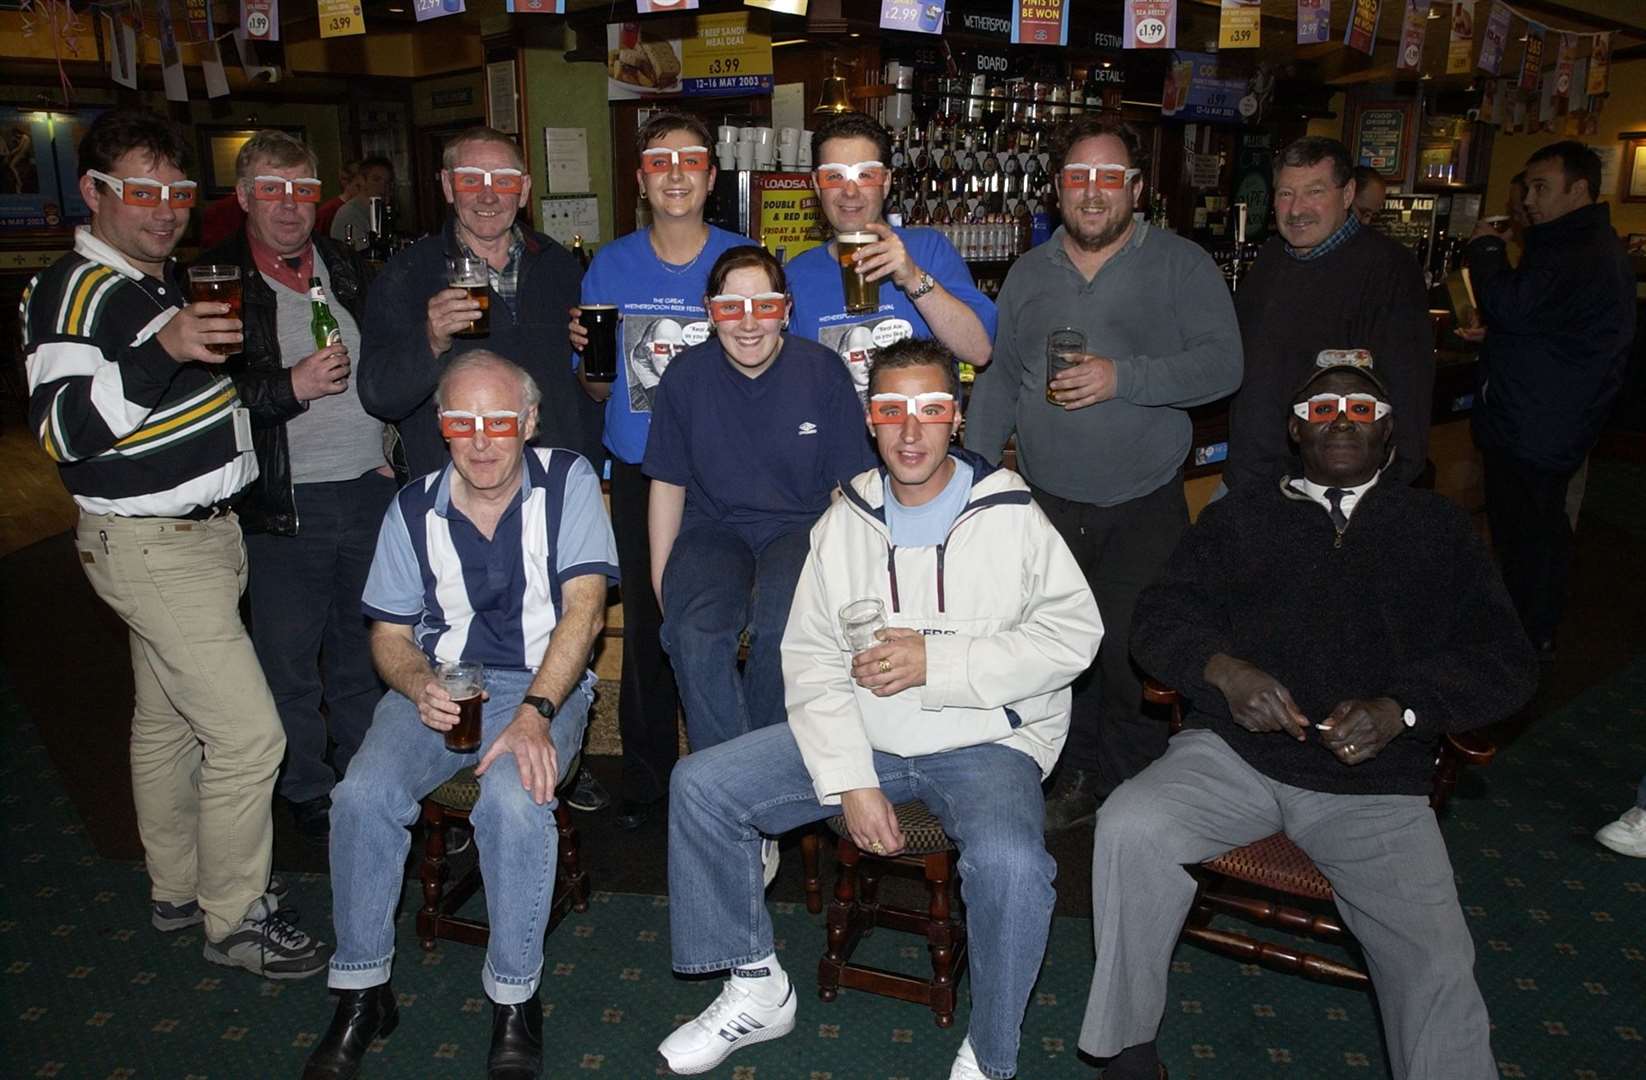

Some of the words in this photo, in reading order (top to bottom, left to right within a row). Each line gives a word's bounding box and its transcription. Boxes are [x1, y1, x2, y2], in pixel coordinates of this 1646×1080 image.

[885, 7, 918, 21] £2.99
[1022, 8, 1033, 18] BE
[1035, 8, 1060, 20] WON
[249, 17, 267, 29] £1.99
[330, 16, 351, 31] £3.99
[963, 14, 1011, 33] WETHERSPOO
[1139, 24, 1163, 37] £1.99
[1229, 30, 1252, 42] £3.99
[1095, 32, 1122, 48] FESTIV
[709, 58, 740, 74] £3.99
[977, 54, 1009, 72] BOARD
[695, 78, 717, 89] 12-16
[719, 77, 737, 88] MAY
[739, 76, 759, 86] 2003
[764, 179, 807, 189] LOADSA
[763, 200, 796, 209] DOUBLE
[1385, 199, 1405, 210] IVAL
[773, 212, 780, 221] &
[784, 212, 801, 221] RED
[764, 226, 788, 235] FRIDAY
